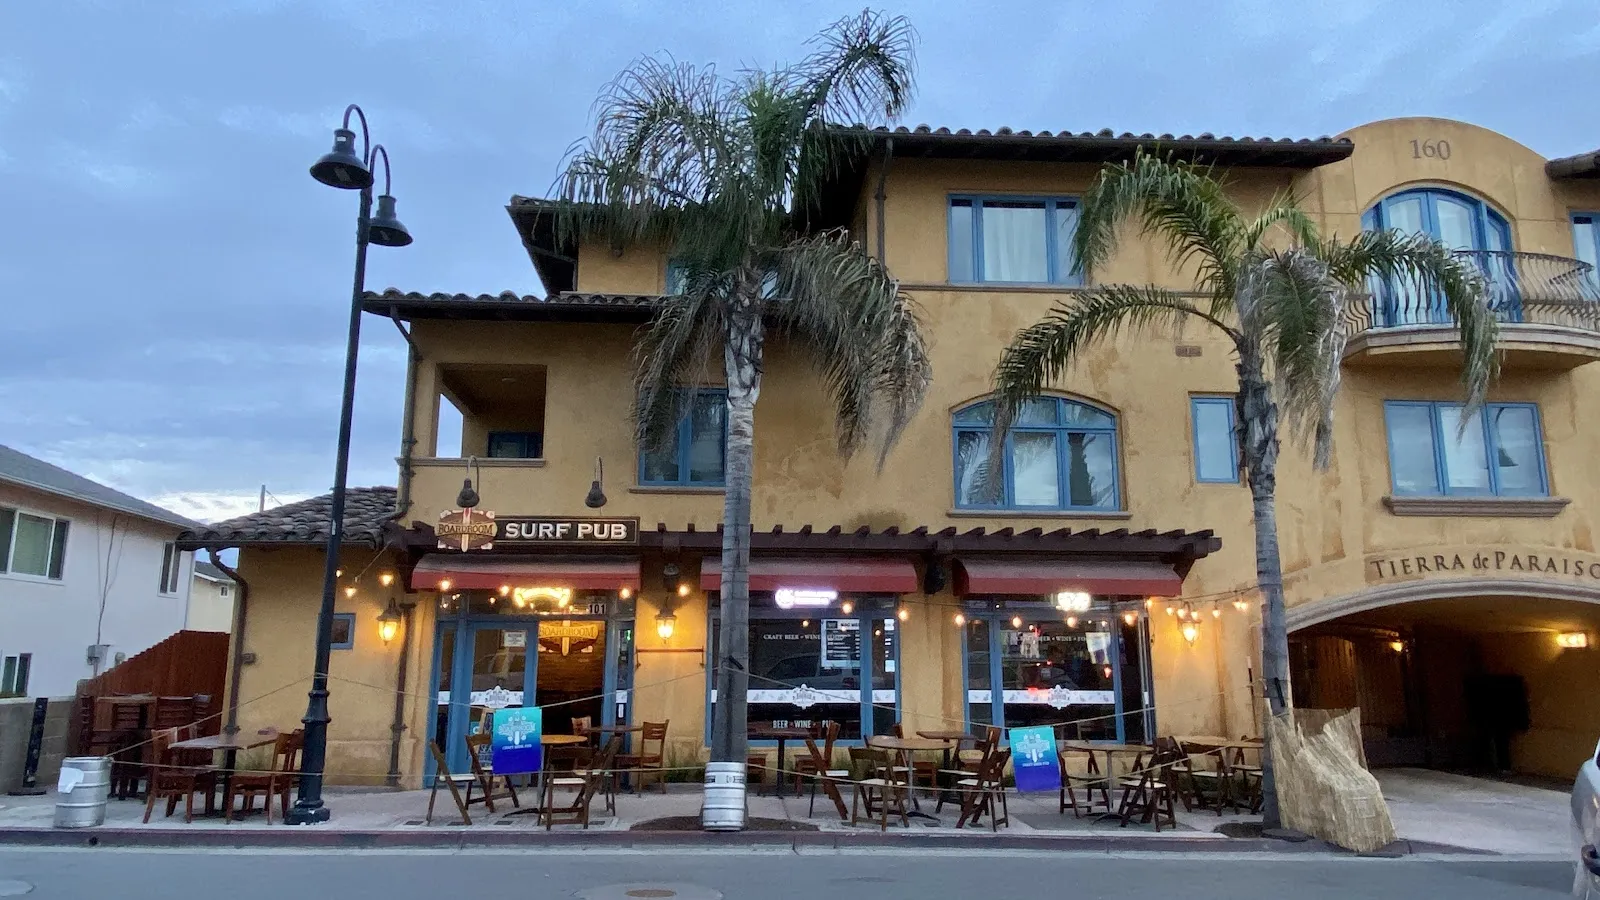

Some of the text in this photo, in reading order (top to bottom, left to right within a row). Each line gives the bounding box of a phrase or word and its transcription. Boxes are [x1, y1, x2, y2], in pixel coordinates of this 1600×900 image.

[1408, 138, 1451, 160] 160
[438, 523, 494, 536] BOARDROOM
[504, 522, 628, 540] SURF PUB
[1369, 550, 1600, 580] TIERRA de PARAISO
[589, 603, 606, 614] 101
[772, 719, 789, 729] BEER
[794, 719, 811, 729] WINE
